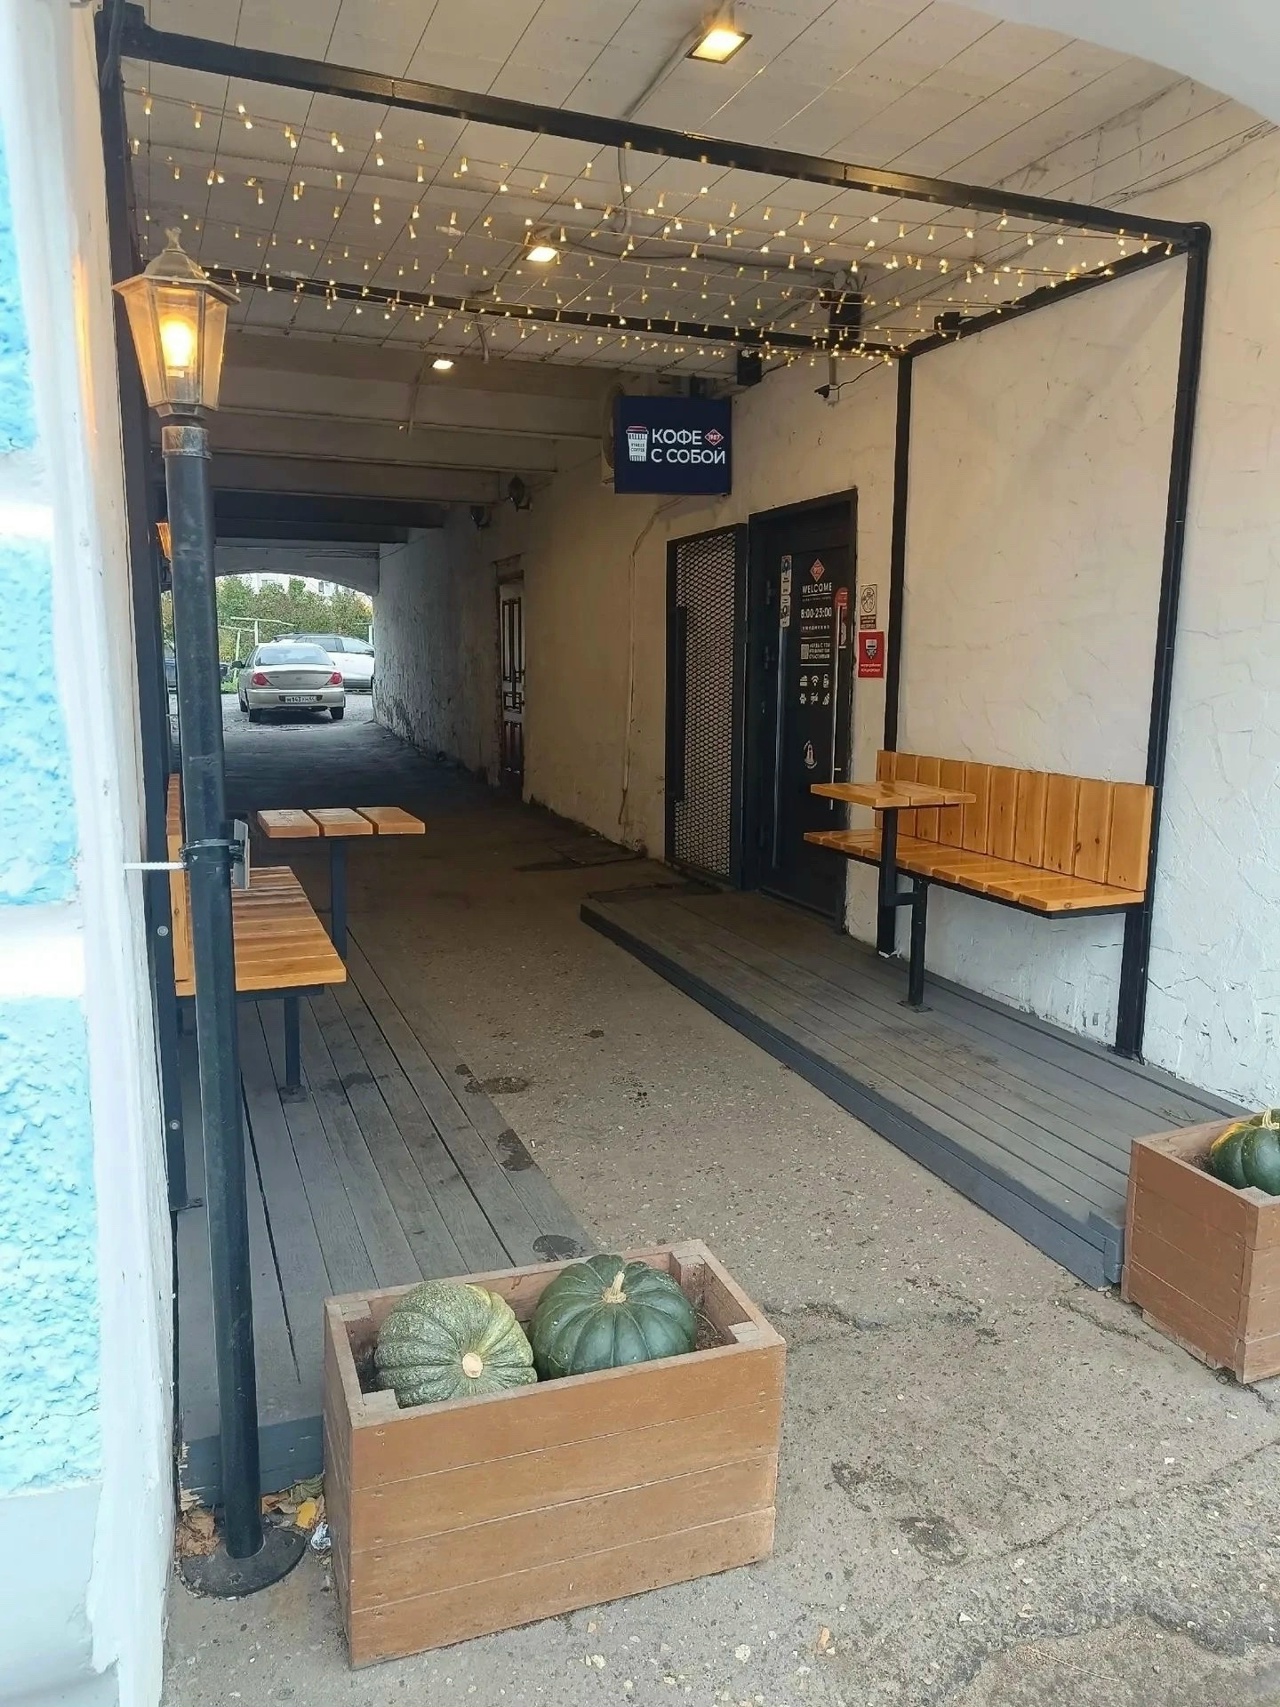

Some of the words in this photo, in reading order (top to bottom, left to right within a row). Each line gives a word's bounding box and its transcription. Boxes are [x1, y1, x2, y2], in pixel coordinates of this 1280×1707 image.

[652, 428, 702, 445] КОФЕ
[651, 448, 663, 463] С
[666, 446, 726, 464] СОБОЙ
[802, 582, 832, 593] WELCOME
